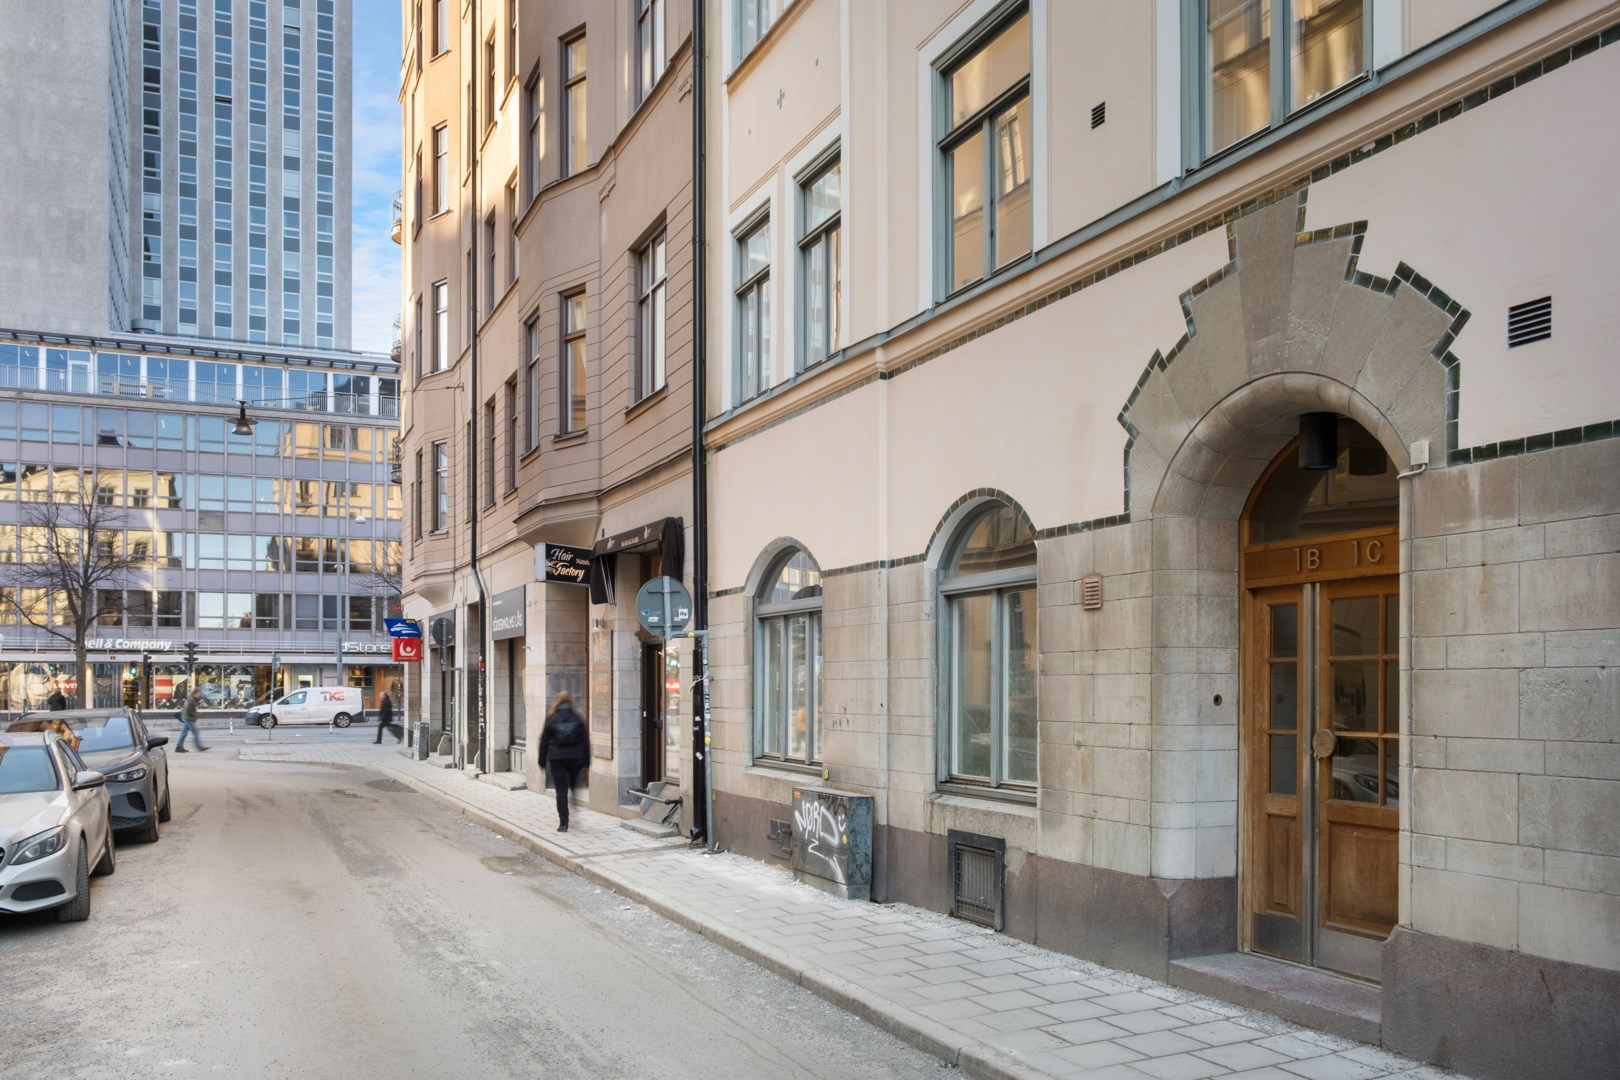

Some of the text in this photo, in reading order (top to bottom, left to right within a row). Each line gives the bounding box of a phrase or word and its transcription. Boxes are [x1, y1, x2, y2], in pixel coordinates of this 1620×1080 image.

[551, 548, 574, 561] Hair
[1294, 540, 1382, 571] 1B 1C
[554, 562, 585, 582] Factory
[104, 639, 114, 649] &
[115, 639, 172, 651] Company
